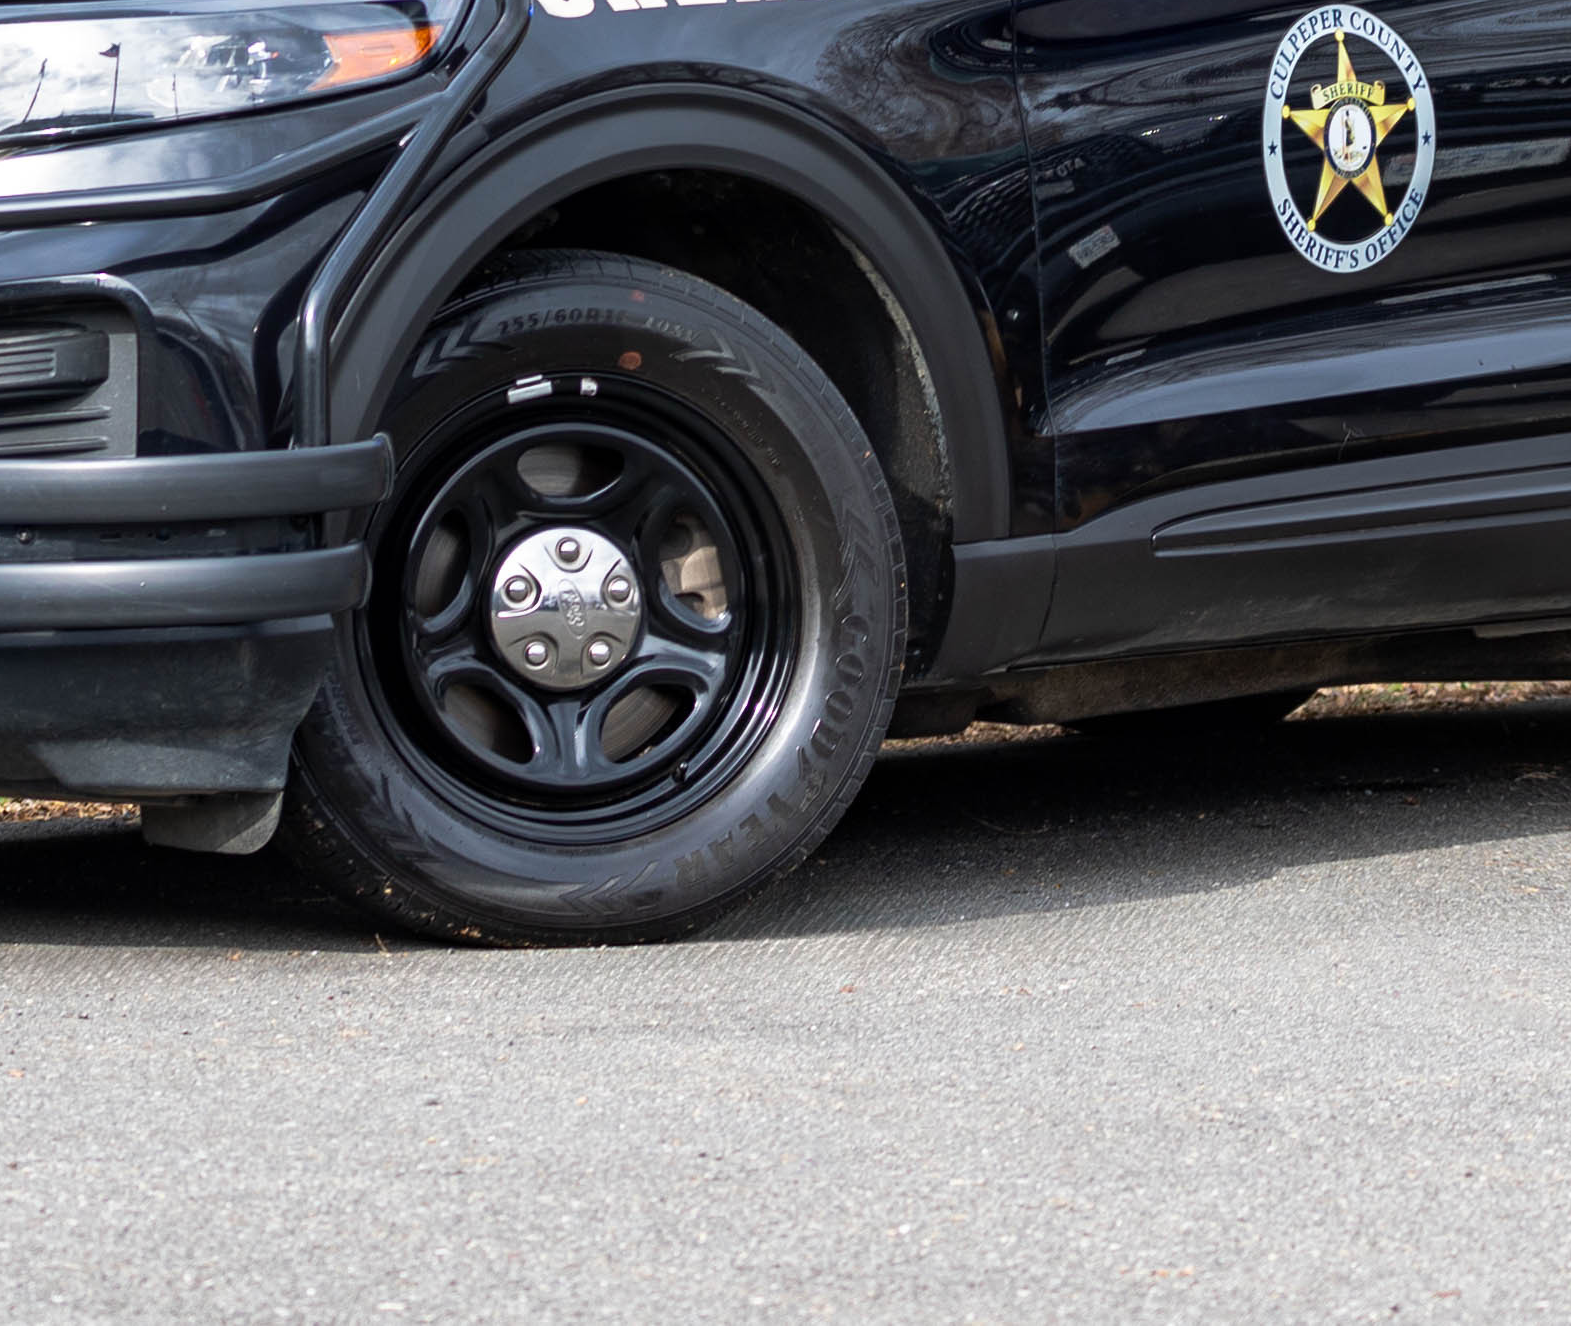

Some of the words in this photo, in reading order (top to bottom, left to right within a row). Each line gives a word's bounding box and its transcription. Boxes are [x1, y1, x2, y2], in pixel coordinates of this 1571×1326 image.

[1270, 8, 1343, 100] CULPEPER
[1350, 11, 1426, 92] COUNTY
[1323, 82, 1373, 102] SHERIFF
[1278, 197, 1359, 270] SHERIFF'S
[1365, 188, 1424, 263] OFFICE
[674, 612, 871, 886] GOODYEAR
